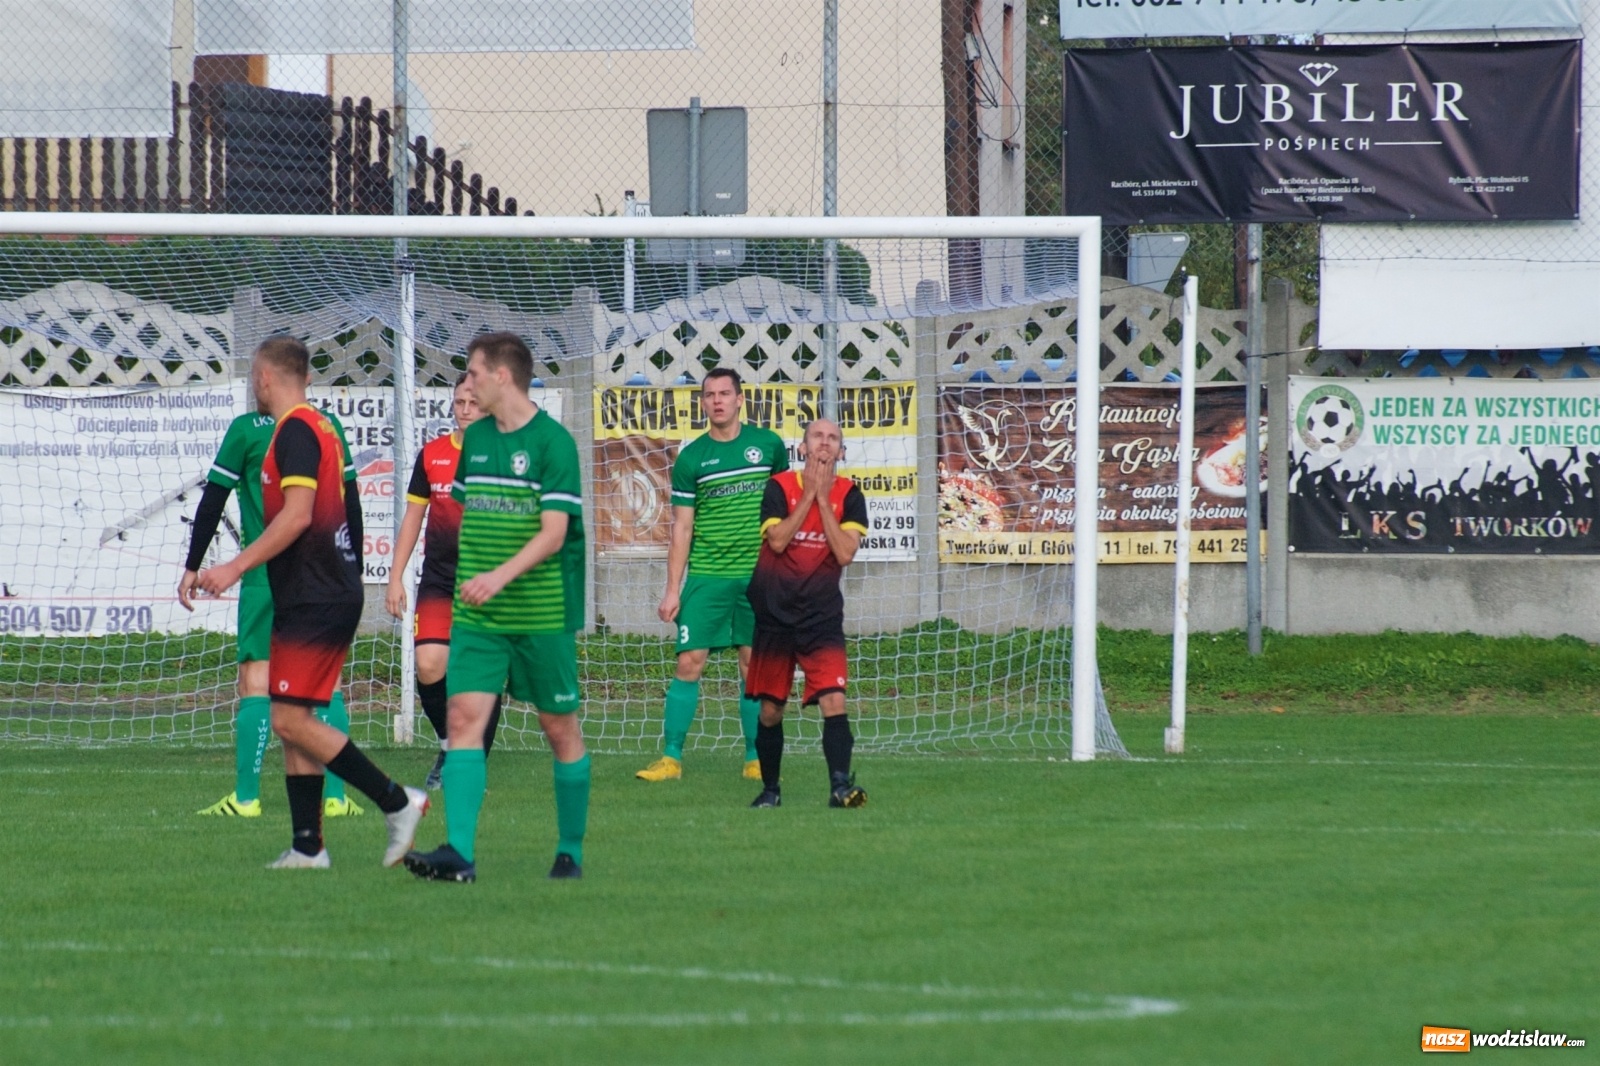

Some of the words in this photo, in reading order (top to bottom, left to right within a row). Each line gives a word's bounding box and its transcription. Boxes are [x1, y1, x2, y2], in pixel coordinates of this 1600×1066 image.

[1264, 135, 1371, 152] POŚPIECH
[1111, 180, 1141, 188] Racibórz,
[72, 392, 234, 409] remontowo-budowlane
[1370, 397, 1434, 418] JEDEN
[1442, 397, 1468, 418] ZA
[78, 416, 158, 433] Docieplenia
[253, 415, 275, 427] LKS
[1373, 424, 1469, 445] WSZYSCY
[1477, 424, 1500, 445] ZA
[1508, 424, 1600, 446] JEDNEGO
[87, 440, 179, 460] wykończenia
[869, 501, 914, 511] PAWLIK
[873, 516, 892, 530] 62
[896, 516, 915, 530] 99
[1339, 511, 1427, 540] LKS
[1450, 510, 1592, 539] TWORKÓW
[900, 535, 916, 549] 41
[946, 538, 1013, 556] Tworków,
[1018, 539, 1036, 555] ul.
[1104, 540, 1120, 554] 11
[1137, 542, 1158, 555] tel.
[1197, 538, 1223, 554] 441
[0, 605, 41, 632] 604
[51, 605, 96, 632] 507
[106, 605, 152, 632] 320
[680, 625, 689, 644] 3
